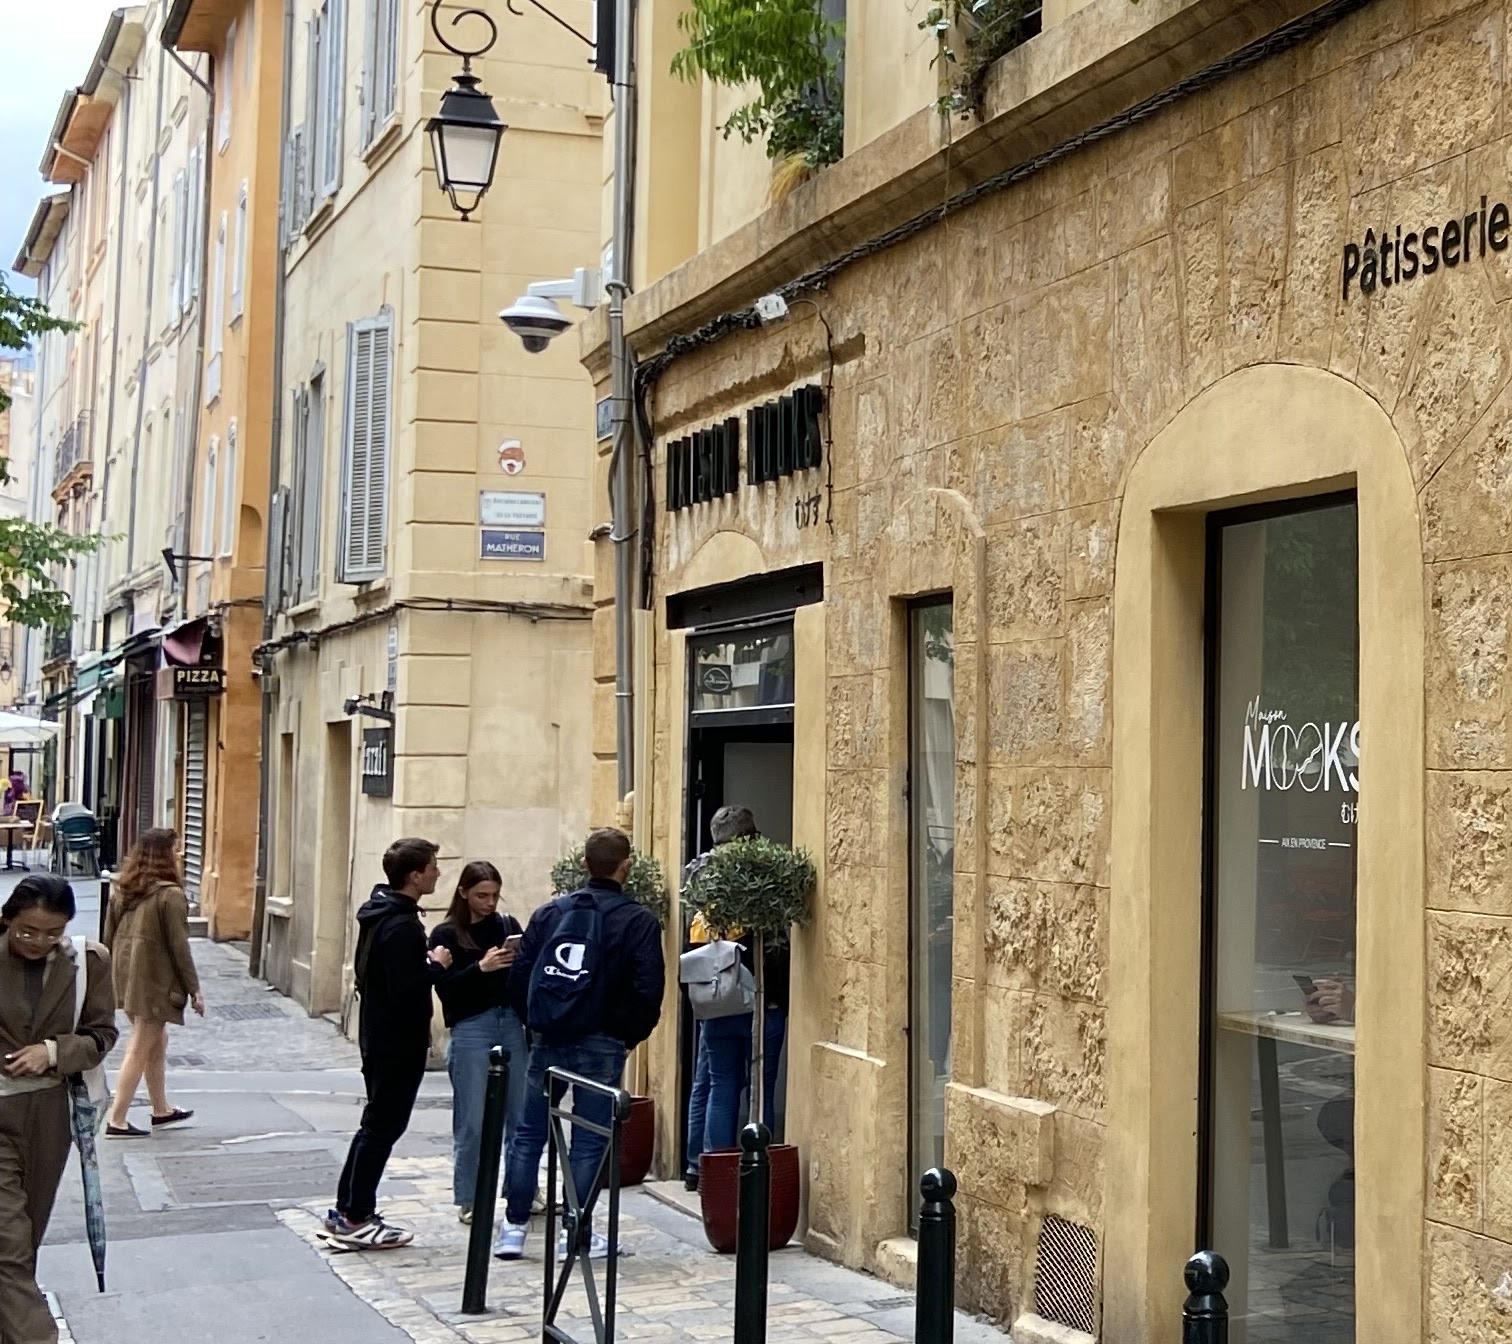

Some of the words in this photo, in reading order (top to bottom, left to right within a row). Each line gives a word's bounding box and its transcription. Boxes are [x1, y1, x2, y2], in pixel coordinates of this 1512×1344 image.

[1341, 195, 1511, 301] Pâtisserie
[504, 533, 520, 541] RUE
[486, 543, 540, 554] MATHERON
[177, 670, 219, 683] PIZZA
[1245, 694, 1287, 731] Maison
